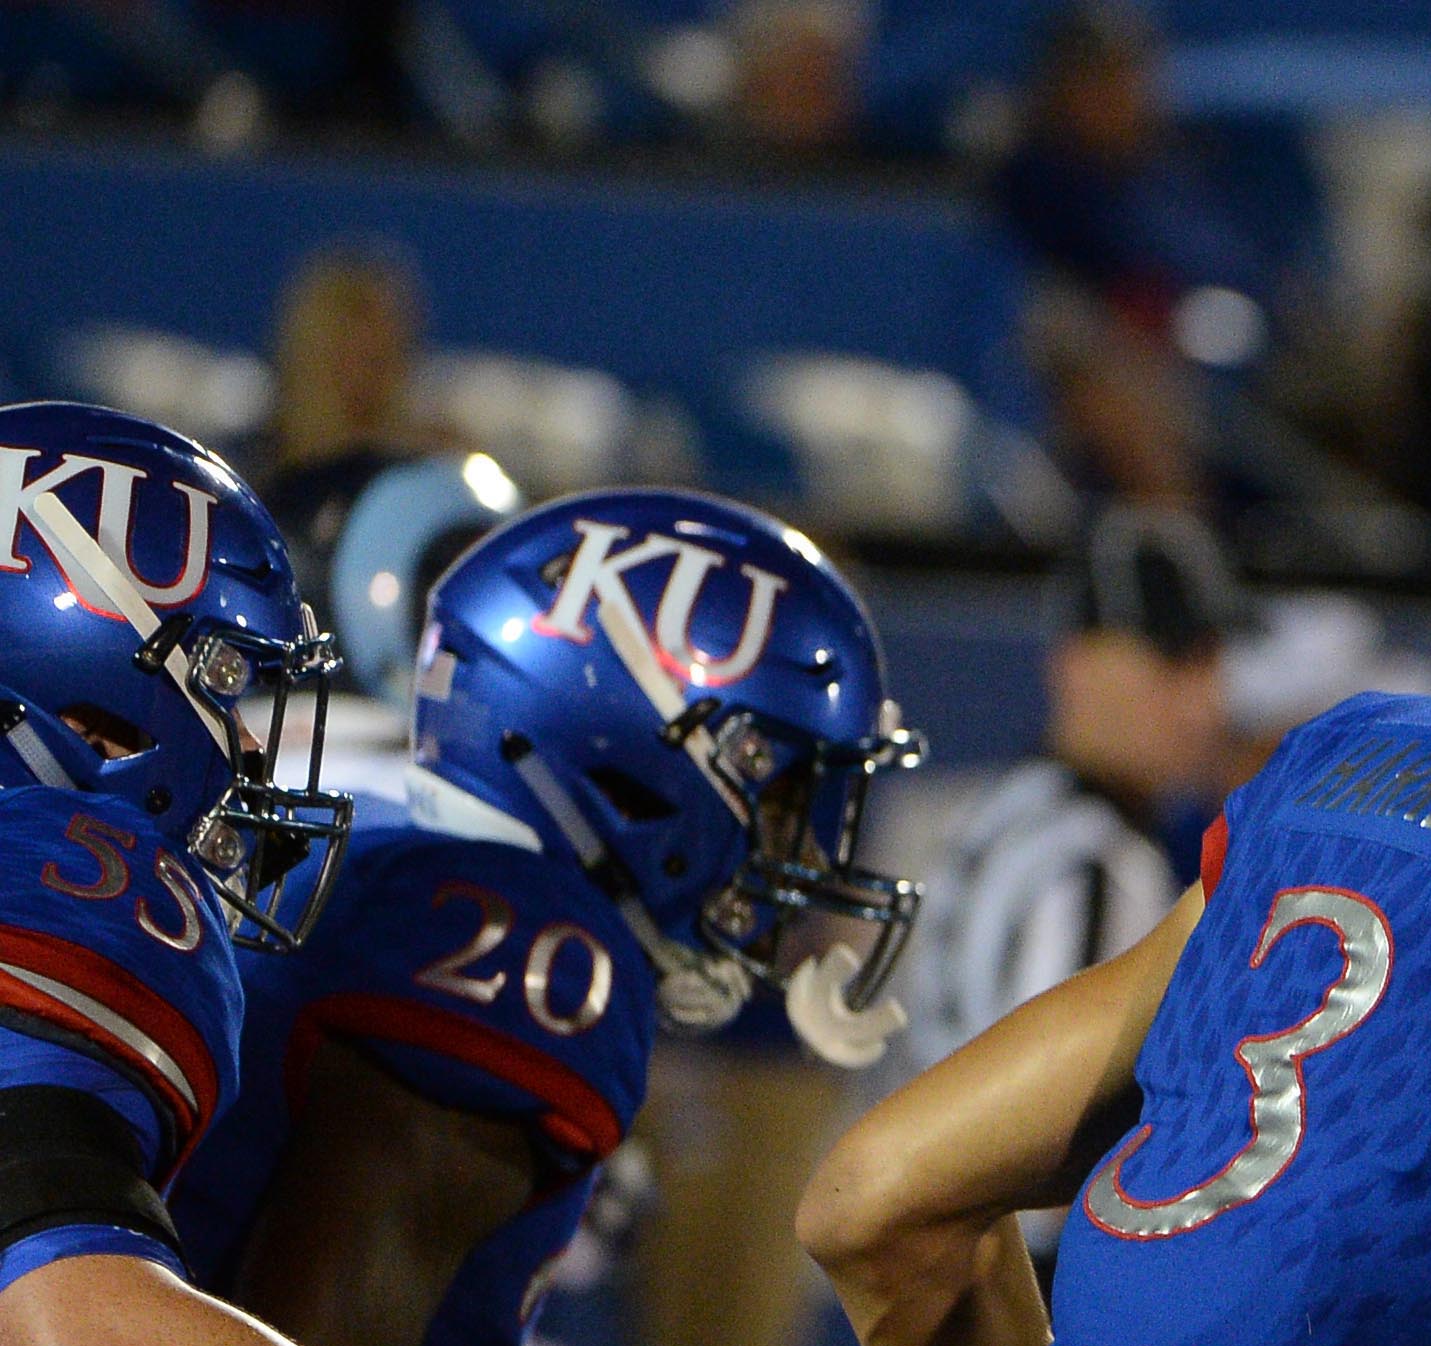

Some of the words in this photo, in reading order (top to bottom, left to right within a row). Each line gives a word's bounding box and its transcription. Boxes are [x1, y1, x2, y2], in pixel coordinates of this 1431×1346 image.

[0, 444, 218, 622] KU
[531, 518, 790, 688] KU
[412, 882, 614, 1038] 20
[1085, 884, 1395, 1240] 3
